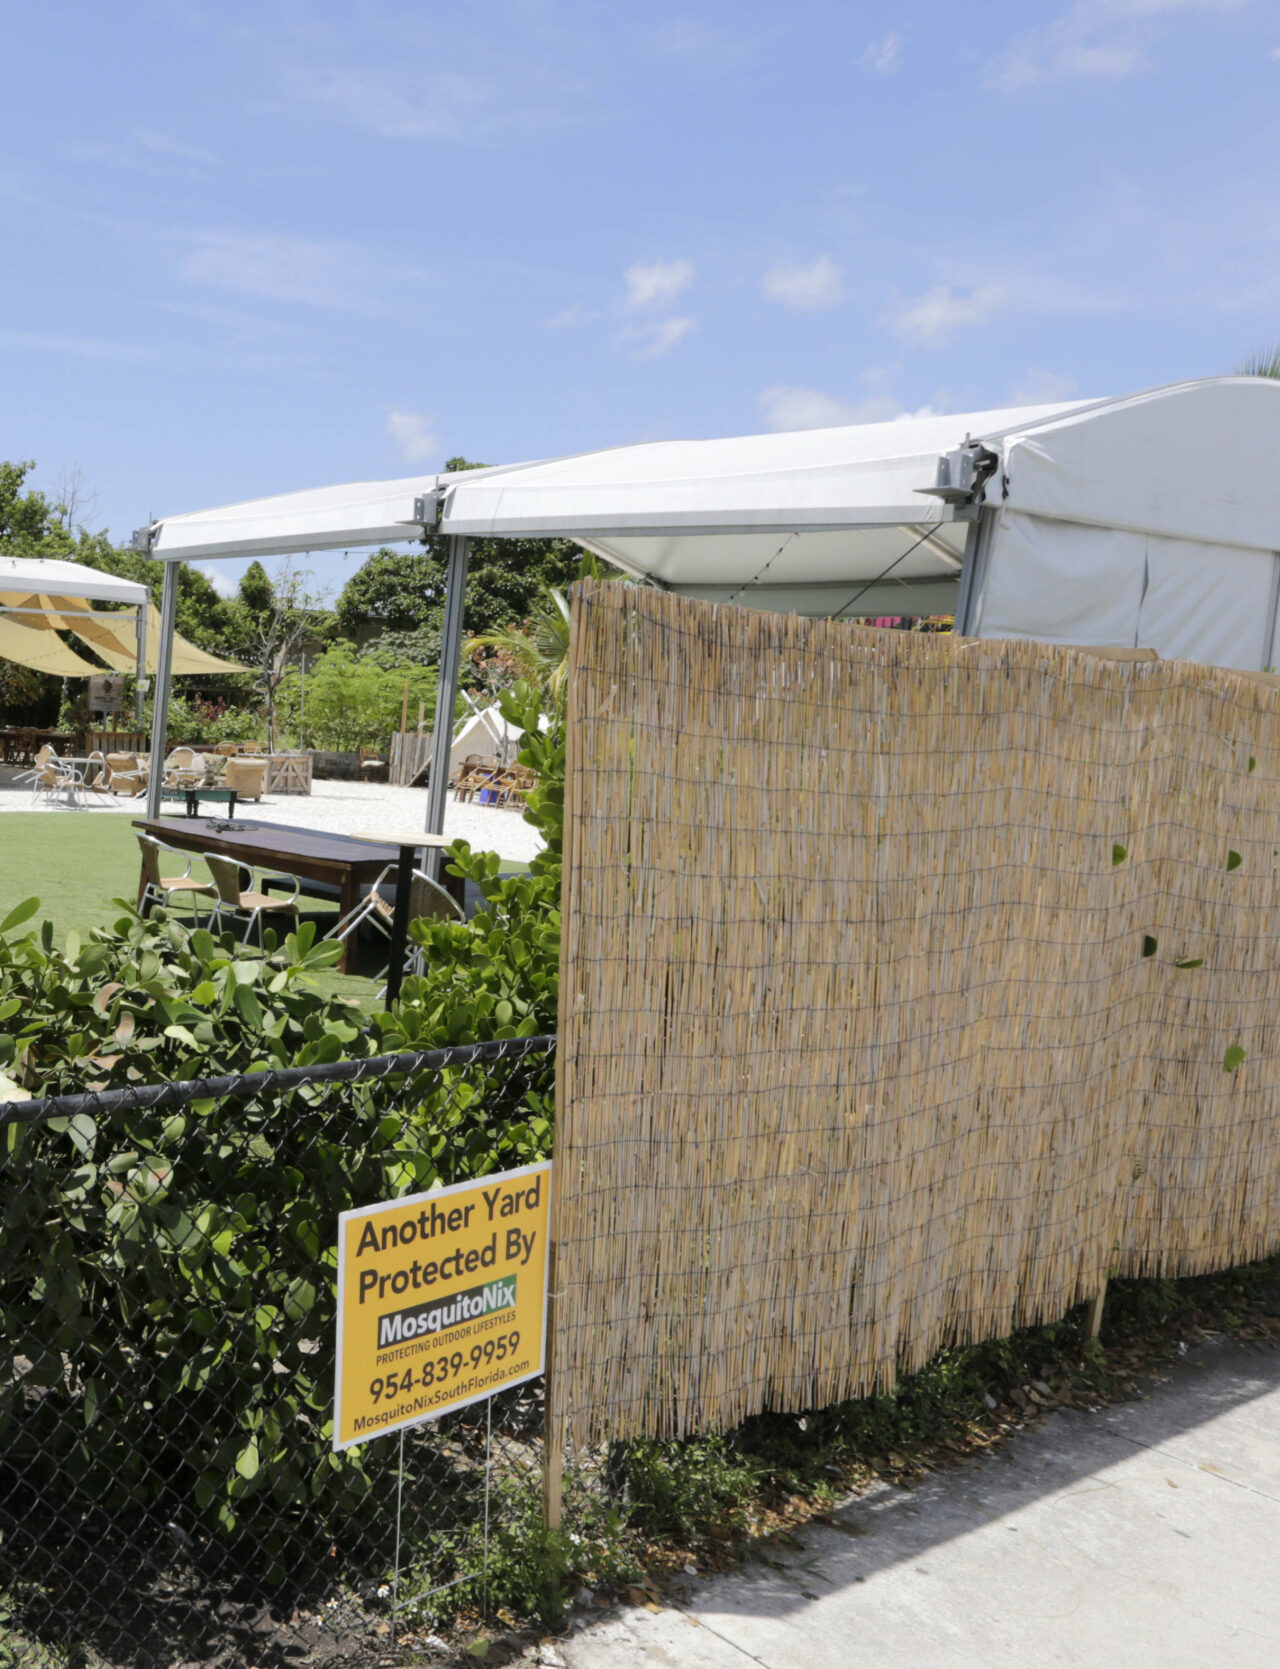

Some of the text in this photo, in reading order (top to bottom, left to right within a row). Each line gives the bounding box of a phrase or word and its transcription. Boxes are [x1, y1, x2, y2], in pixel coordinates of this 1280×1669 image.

[355, 1175, 541, 1257] Another Yard
[359, 1227, 537, 1305] Protected By
[376, 1310, 517, 1367] PROTECTING OUTDOOR LIFESTYLES
[379, 1280, 516, 1347] MosquitoNix
[353, 1359, 530, 1433] MosquitoNixSouthFlorida.com
[369, 1330, 521, 1405] 954-839-9959
